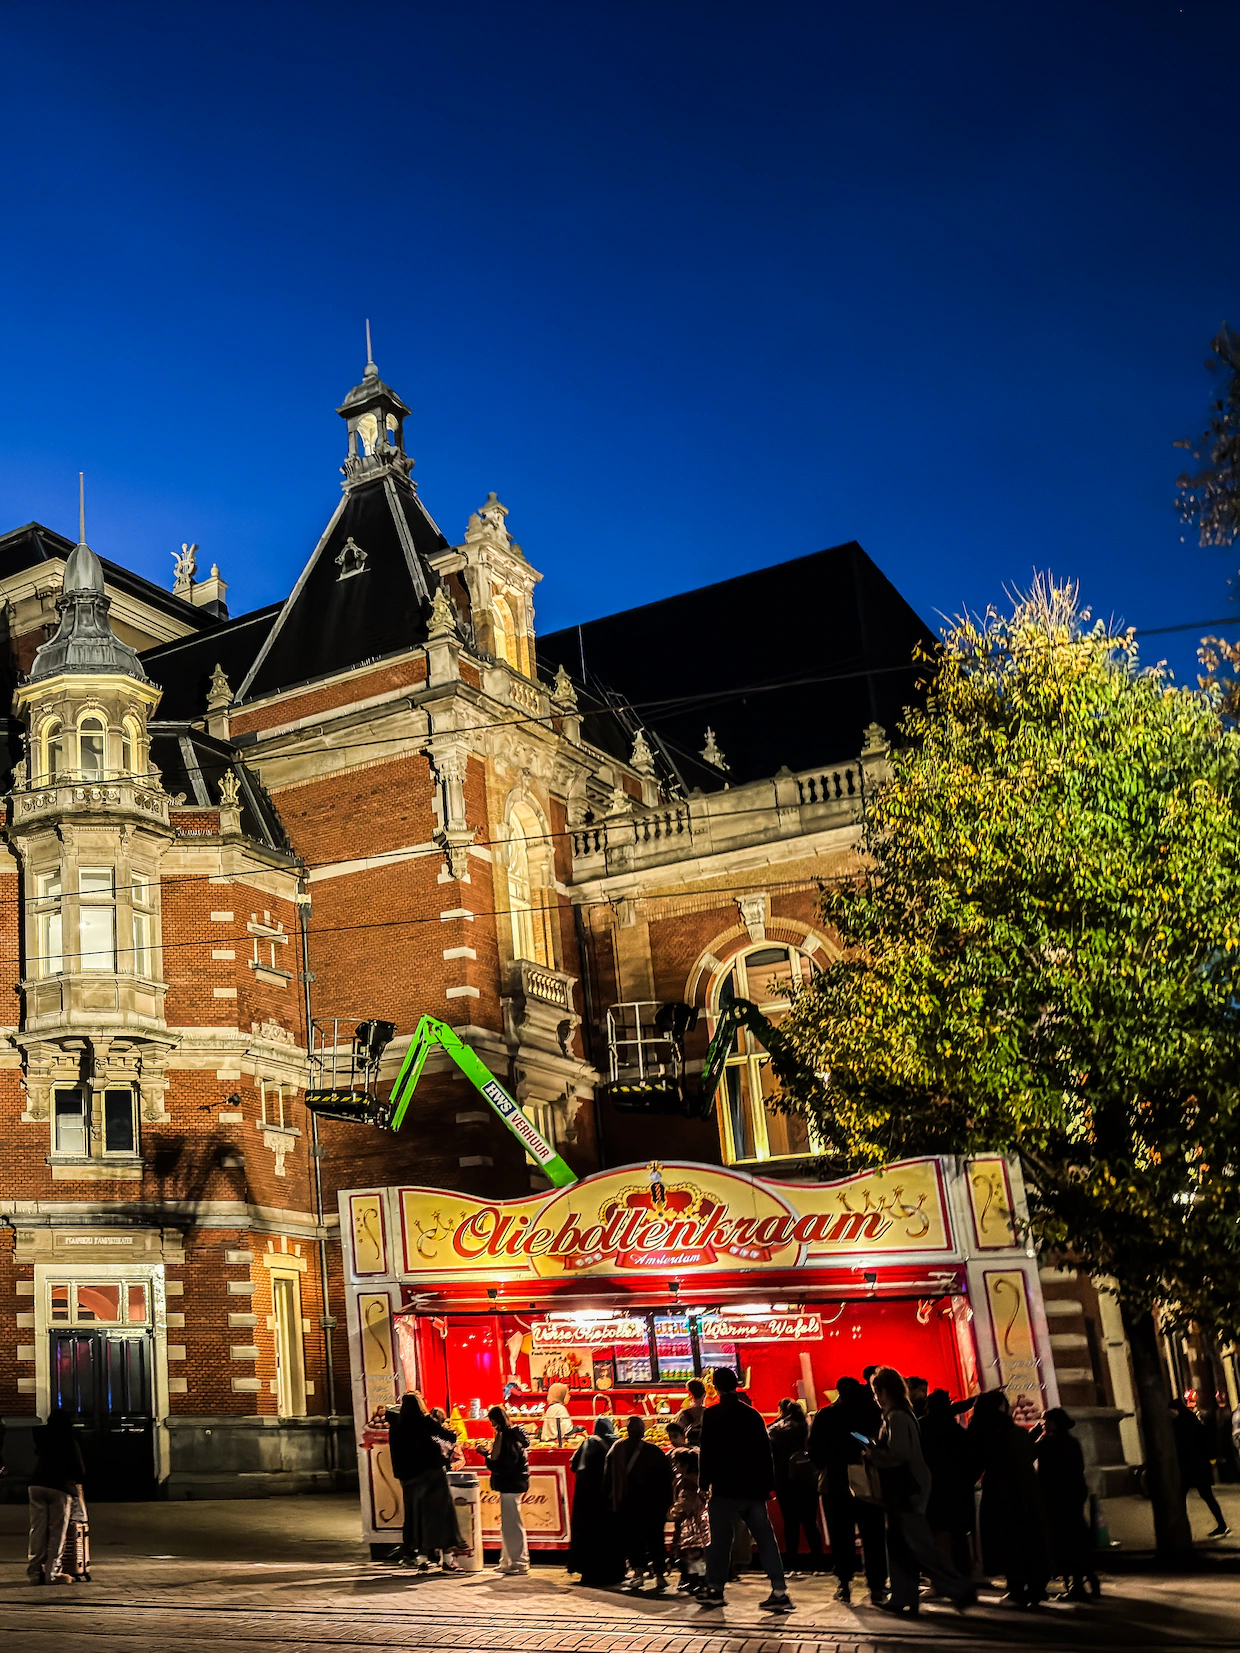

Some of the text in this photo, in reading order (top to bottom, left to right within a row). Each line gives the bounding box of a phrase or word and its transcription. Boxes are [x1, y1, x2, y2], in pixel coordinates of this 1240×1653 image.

[485, 1083, 550, 1159] HWS VERHUUR
[452, 1203, 893, 1261] Oliebollenkraam
[629, 1252, 701, 1265] Amsterdam
[533, 1325, 573, 1341] Verse
[704, 1317, 820, 1339] Warme Wafels
